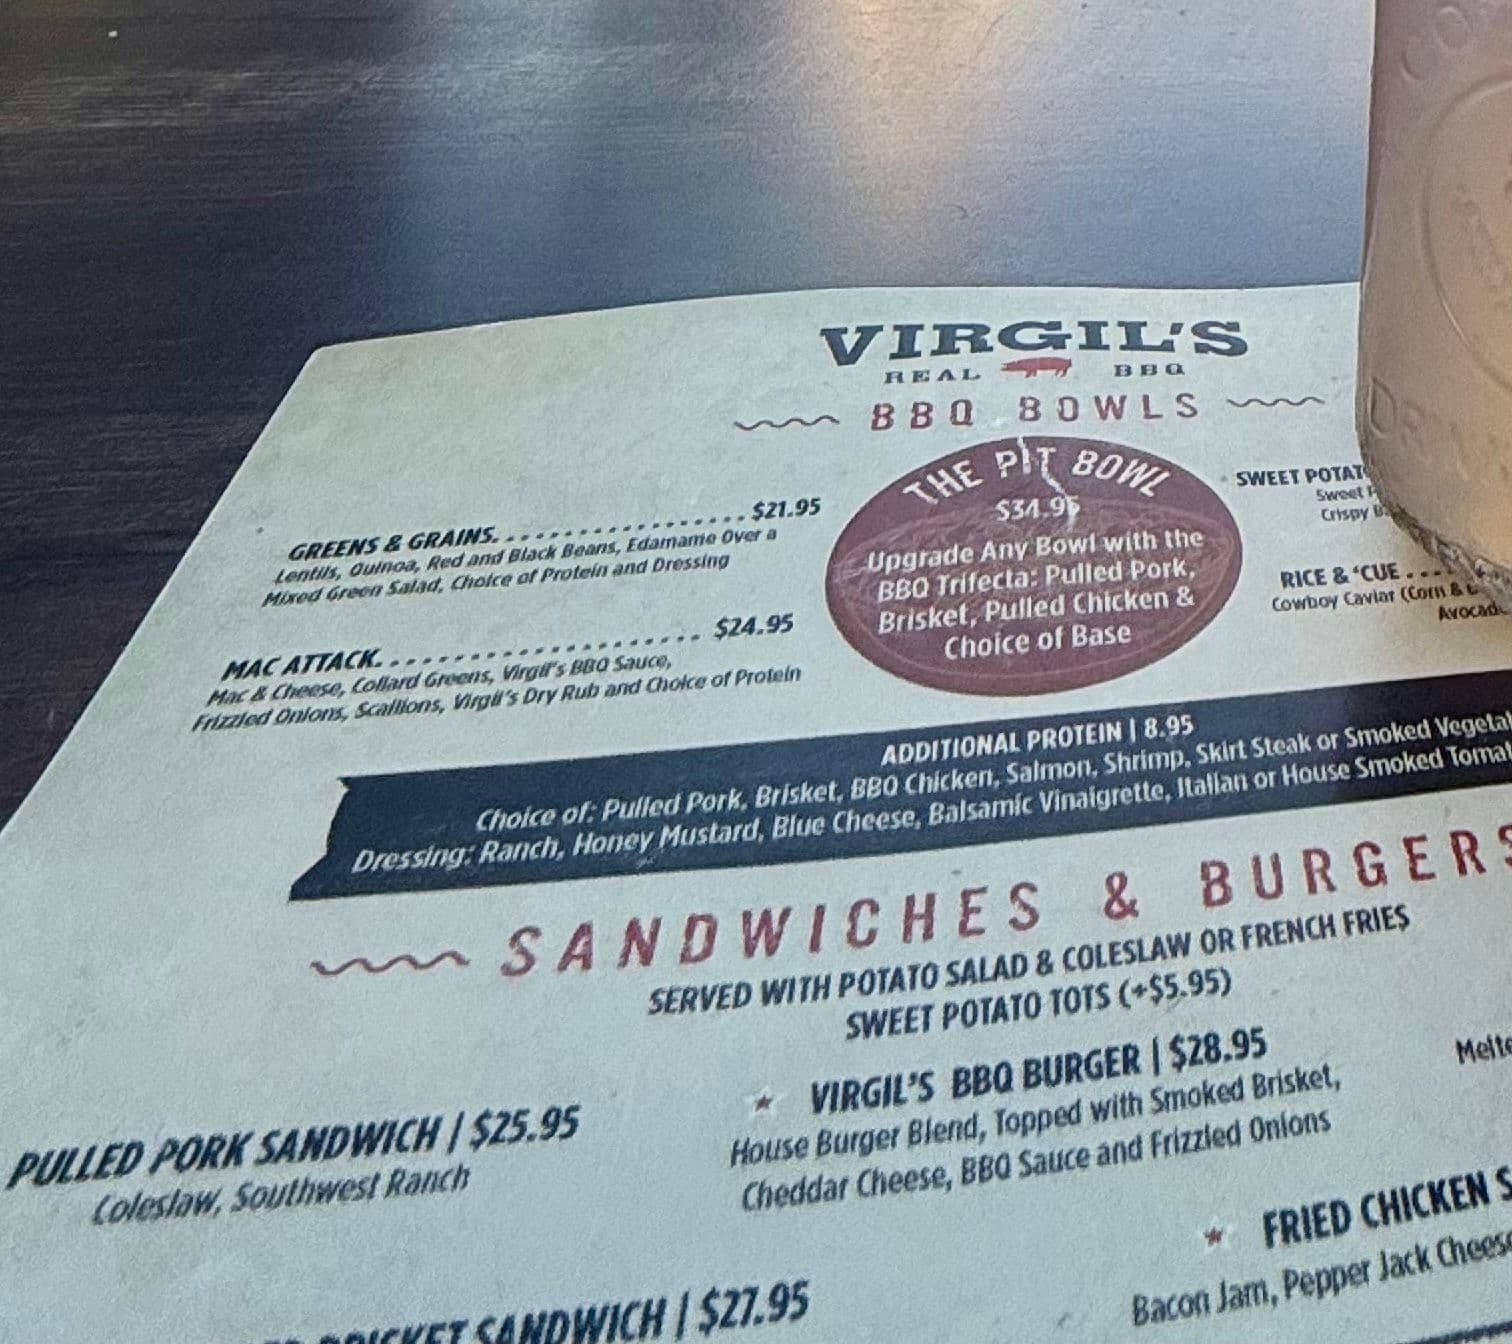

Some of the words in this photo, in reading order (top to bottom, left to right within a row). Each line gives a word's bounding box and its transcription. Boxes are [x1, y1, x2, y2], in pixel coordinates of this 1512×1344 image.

[819, 320, 1249, 367] VIRGIL'S
[883, 368, 981, 385] REAL
[1113, 362, 1186, 378] BBQ
[870, 397, 975, 431] BBQ
[1017, 392, 1199, 423] BOWLS
[902, 459, 985, 507] THE
[994, 445, 1057, 481] PIT
[1070, 449, 1171, 499] BOWL
[1235, 468, 1301, 487] SWEET
[750, 497, 821, 522] $21.95
[995, 494, 1080, 524] $34.95
[287, 536, 380, 561] GREENS
[382, 534, 403, 553] &
[867, 543, 974, 574] Upgrade
[979, 539, 1028, 562] Any
[1035, 532, 1095, 557] Bowl
[1102, 529, 1157, 552] with
[1164, 528, 1203, 550] the
[877, 575, 929, 603] BBQ
[936, 568, 1037, 597] Trifecta:
[1045, 559, 1122, 586] Pulled
[1129, 556, 1195, 580] Pork,
[1280, 568, 1328, 589] RICE
[1332, 566, 1350, 585] &
[713, 612, 793, 640] $24.95
[878, 601, 977, 634] Brisket,
[984, 593, 1065, 622] Pulled
[1072, 587, 1169, 614] Chicken
[1175, 585, 1195, 607] &
[944, 631, 1029, 660] Choice
[1036, 625, 1063, 650] of
[1071, 623, 1131, 648] Base
[220, 656, 281, 681] MAC
[880, 731, 1020, 766] ADDITIONAL
[1026, 720, 1122, 752] PROTEIN
[1143, 713, 1194, 739] 8.95
[475, 805, 556, 832] Choice
[561, 800, 597, 825] of:
[601, 792, 681, 821] Pulled
[684, 787, 747, 814] Pork,
[754, 780, 843, 808] Brisket,
[850, 774, 898, 800] BBQ
[904, 768, 1000, 795] Chicken,
[1006, 758, 1098, 784] Salmon,
[1103, 748, 1191, 774] Shrimp,
[1195, 739, 1247, 764] Skirt
[1250, 732, 1311, 758] Steak
[1316, 732, 1338, 750] or
[1343, 718, 1431, 748] Smoked
[352, 842, 475, 874] Dressing:
[479, 835, 564, 864] Ranch,
[571, 830, 654, 856] Honey
[658, 816, 764, 848] Mustard,
[771, 813, 825, 839] Blue
[832, 808, 921, 834] Cheese,
[929, 795, 1033, 828] Balsamic
[1038, 780, 1171, 813] Vinaigrette,
[1176, 771, 1248, 798] Italian
[1253, 770, 1276, 789] or
[1281, 762, 1350, 786] House
[1354, 749, 1445, 778] Smoked
[502, 886, 1043, 978] SANDWICHES
[1103, 869, 1140, 917] &
[647, 981, 752, 1015] SERVED
[760, 973, 831, 1006] WITH
[837, 961, 939, 998] POTATO
[945, 952, 1029, 987] SALAD
[1034, 948, 1053, 976] &
[1061, 931, 1191, 972] COLESLAW
[1199, 927, 1235, 955] OR
[1240, 914, 1337, 950] FRENCH
[1342, 903, 1410, 936] FRIES
[845, 1003, 934, 1040] SWEET
[941, 990, 1041, 1031] POTATO
[1049, 981, 1111, 1017] TOTS
[1118, 965, 1231, 1010] (+$5.95)
[811, 1070, 935, 1114] VIRGIL'S
[951, 1060, 1013, 1100] BBQ
[1022, 1042, 1141, 1091] BURGER
[1168, 1025, 1267, 1073] $28.95
[729, 1136, 809, 1168] House
[815, 1126, 900, 1158] Burger
[907, 1111, 986, 1149] Blend,
[993, 1097, 1082, 1136] Topped
[1089, 1090, 1143, 1122] with
[1149, 1074, 1244, 1115] Smoked
[1251, 1062, 1341, 1100] Brisket,
[4, 1140, 145, 1190] PULLED
[147, 1131, 254, 1175] PORK
[253, 1115, 443, 1166] SANDWICH
[468, 1104, 580, 1152] $25.95
[741, 1173, 849, 1211] Cheddar
[856, 1165, 953, 1200] Cheese,
[960, 1151, 1011, 1185] BBQ
[1017, 1146, 1091, 1177] Sauce
[1096, 1133, 1143, 1166] and
[1150, 1118, 1241, 1159] Frizzled
[1248, 1110, 1331, 1143] Onions
[1262, 1199, 1352, 1249] FRIED
[1359, 1170, 1490, 1229] CHICKEN
[1131, 1290, 1210, 1327] Bacon
[1217, 1277, 1278, 1313] Jam,
[1281, 1259, 1370, 1300] Pepper
[1379, 1242, 1432, 1281] Jack
[474, 1295, 667, 1344] SANDWICH
[698, 1280, 808, 1331] $27.95
